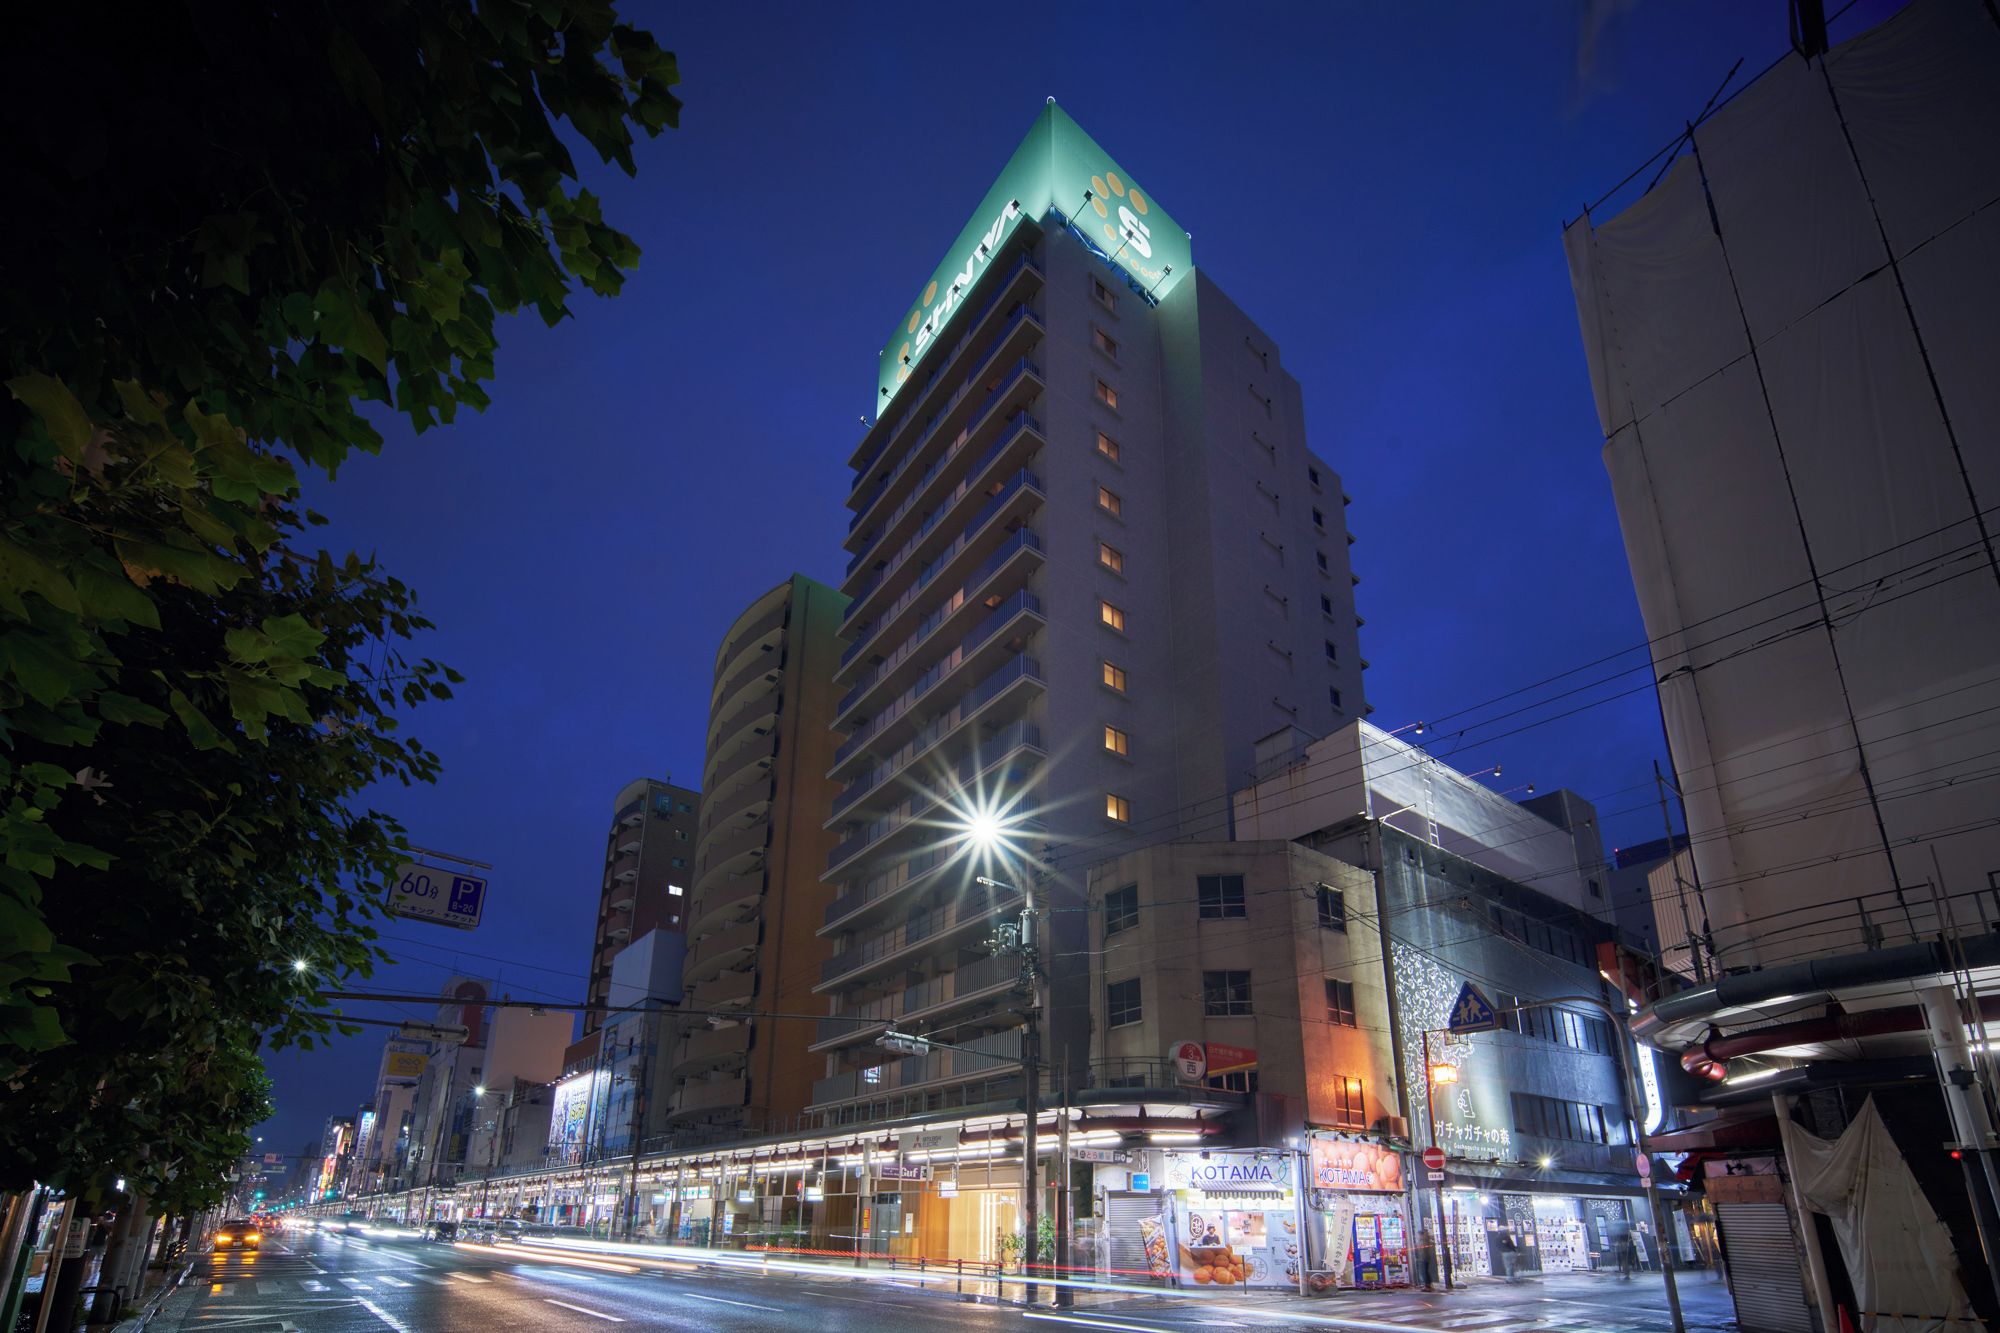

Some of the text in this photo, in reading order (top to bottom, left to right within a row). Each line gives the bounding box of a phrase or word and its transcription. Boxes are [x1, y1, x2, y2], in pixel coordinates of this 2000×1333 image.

[400, 872, 439, 899] 60分
[456, 879, 475, 902] P
[452, 901, 474, 914] 8-20
[1186, 1061, 1196, 1074] 西
[1434, 1120, 1511, 1146] ガチャガチャの森
[901, 1165, 919, 1178] Guf
[1191, 1165, 1273, 1180] KOTAMA
[1318, 1167, 1367, 1185] KOTAMA
